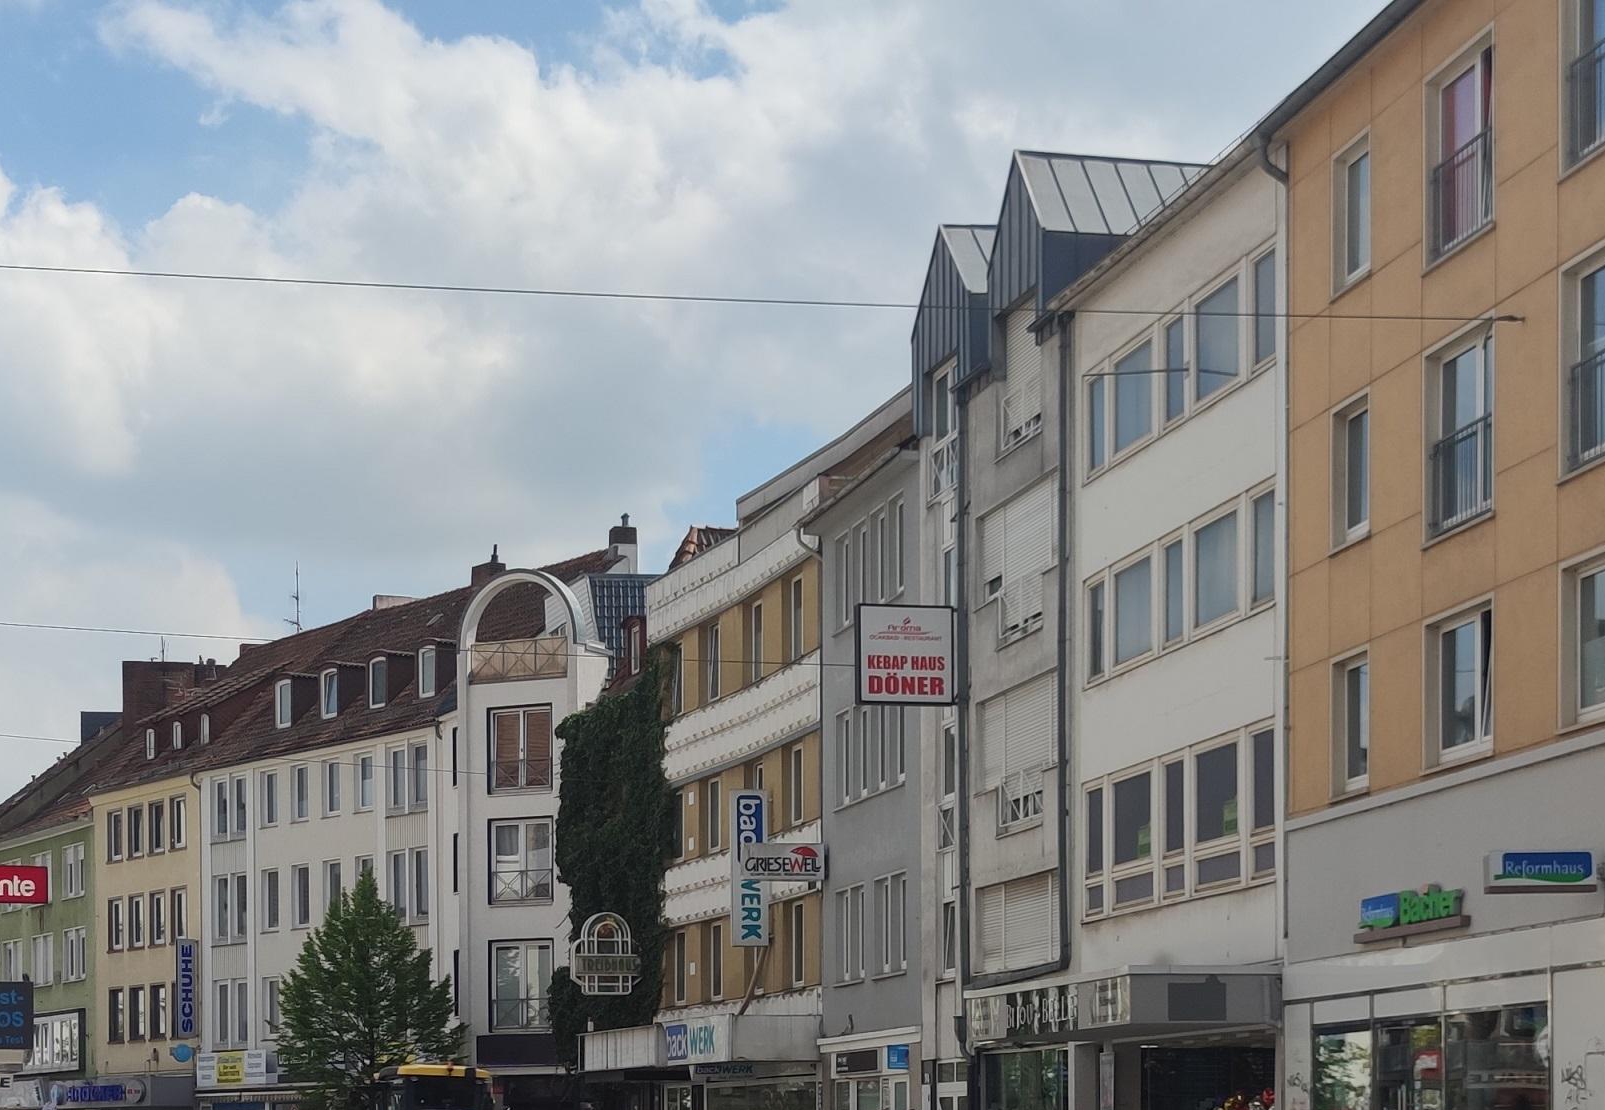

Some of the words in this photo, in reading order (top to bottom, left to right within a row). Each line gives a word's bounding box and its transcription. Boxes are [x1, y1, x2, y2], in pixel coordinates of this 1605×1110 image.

[867, 654, 908, 670] KEBAP
[911, 656, 945, 671] HAUS
[868, 672, 945, 696] DÖNER
[739, 799, 761, 845] bac
[744, 857, 822, 873] GRIESEWELL
[1505, 860, 1584, 879] Reformhaus
[181, 944, 193, 1033] SCHUHE
[5, 1035, 25, 1046] Test
